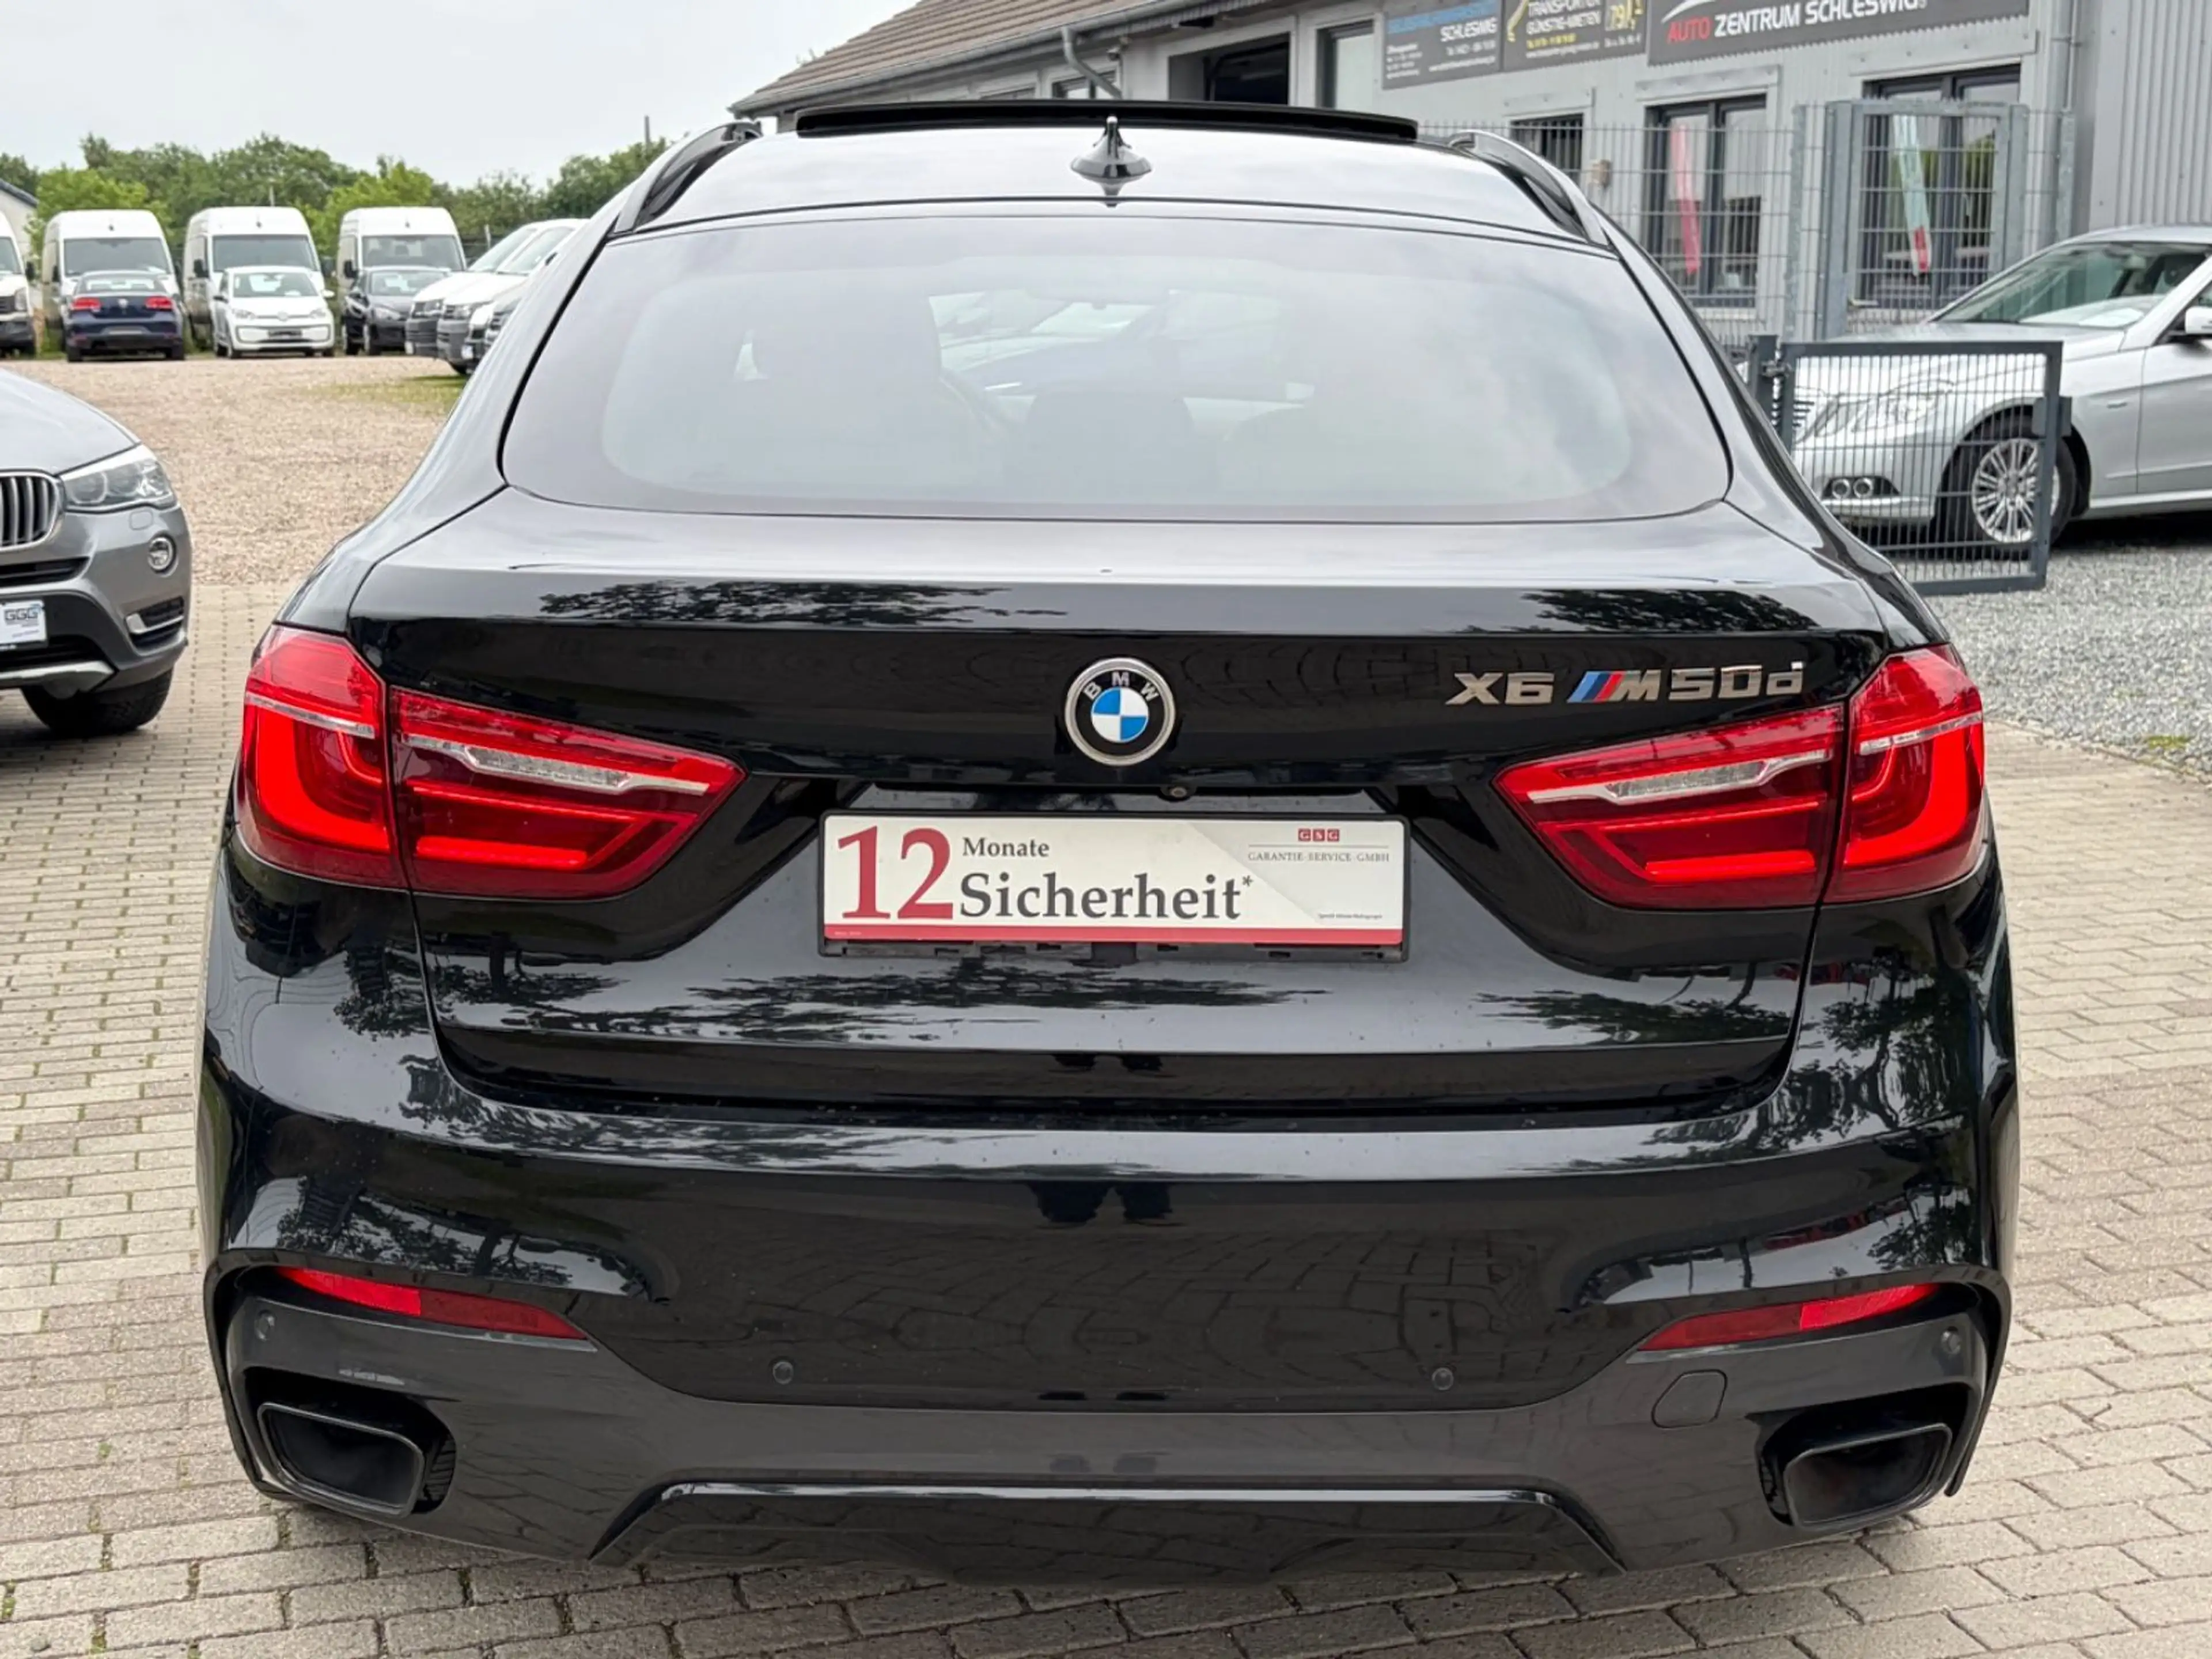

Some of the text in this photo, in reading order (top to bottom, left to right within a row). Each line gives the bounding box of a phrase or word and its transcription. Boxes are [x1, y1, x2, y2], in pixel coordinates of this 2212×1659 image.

[1668, 16, 1711, 43] AUTO
[1714, 3, 1801, 37] ZENTRUM
[1083, 671, 1160, 702] BMW
[1444, 672, 1555, 705] X6
[962, 837, 1050, 857] Monate
[1298, 828, 1340, 842] GSG
[838, 825, 953, 919] 12
[1248, 852, 1305, 862] GARANTIE
